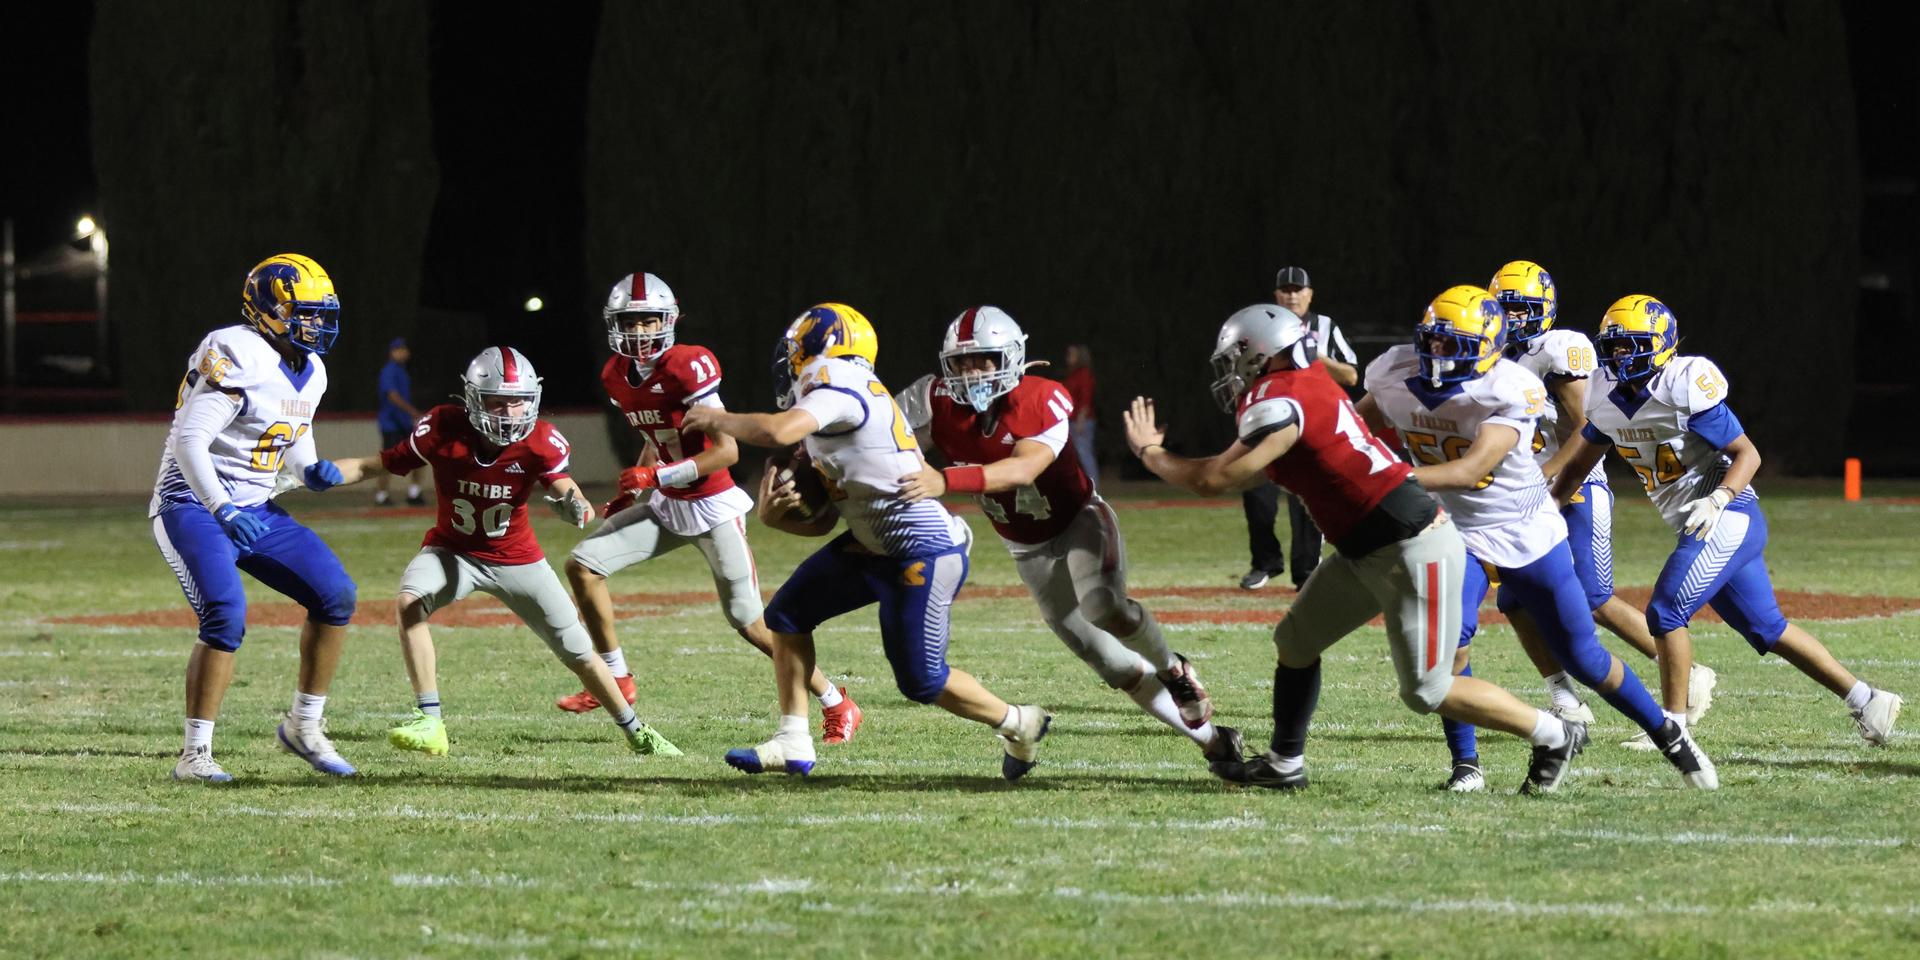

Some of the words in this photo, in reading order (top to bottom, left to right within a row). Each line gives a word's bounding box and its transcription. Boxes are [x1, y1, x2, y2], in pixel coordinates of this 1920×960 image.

[200, 348, 232, 383] 66
[1567, 347, 1593, 371] 88
[1696, 367, 1726, 400] 54
[626, 410, 665, 427] TRIBE
[1616, 442, 1687, 491] 54
[458, 479, 513, 499] TRIBE
[452, 499, 514, 538] 30
